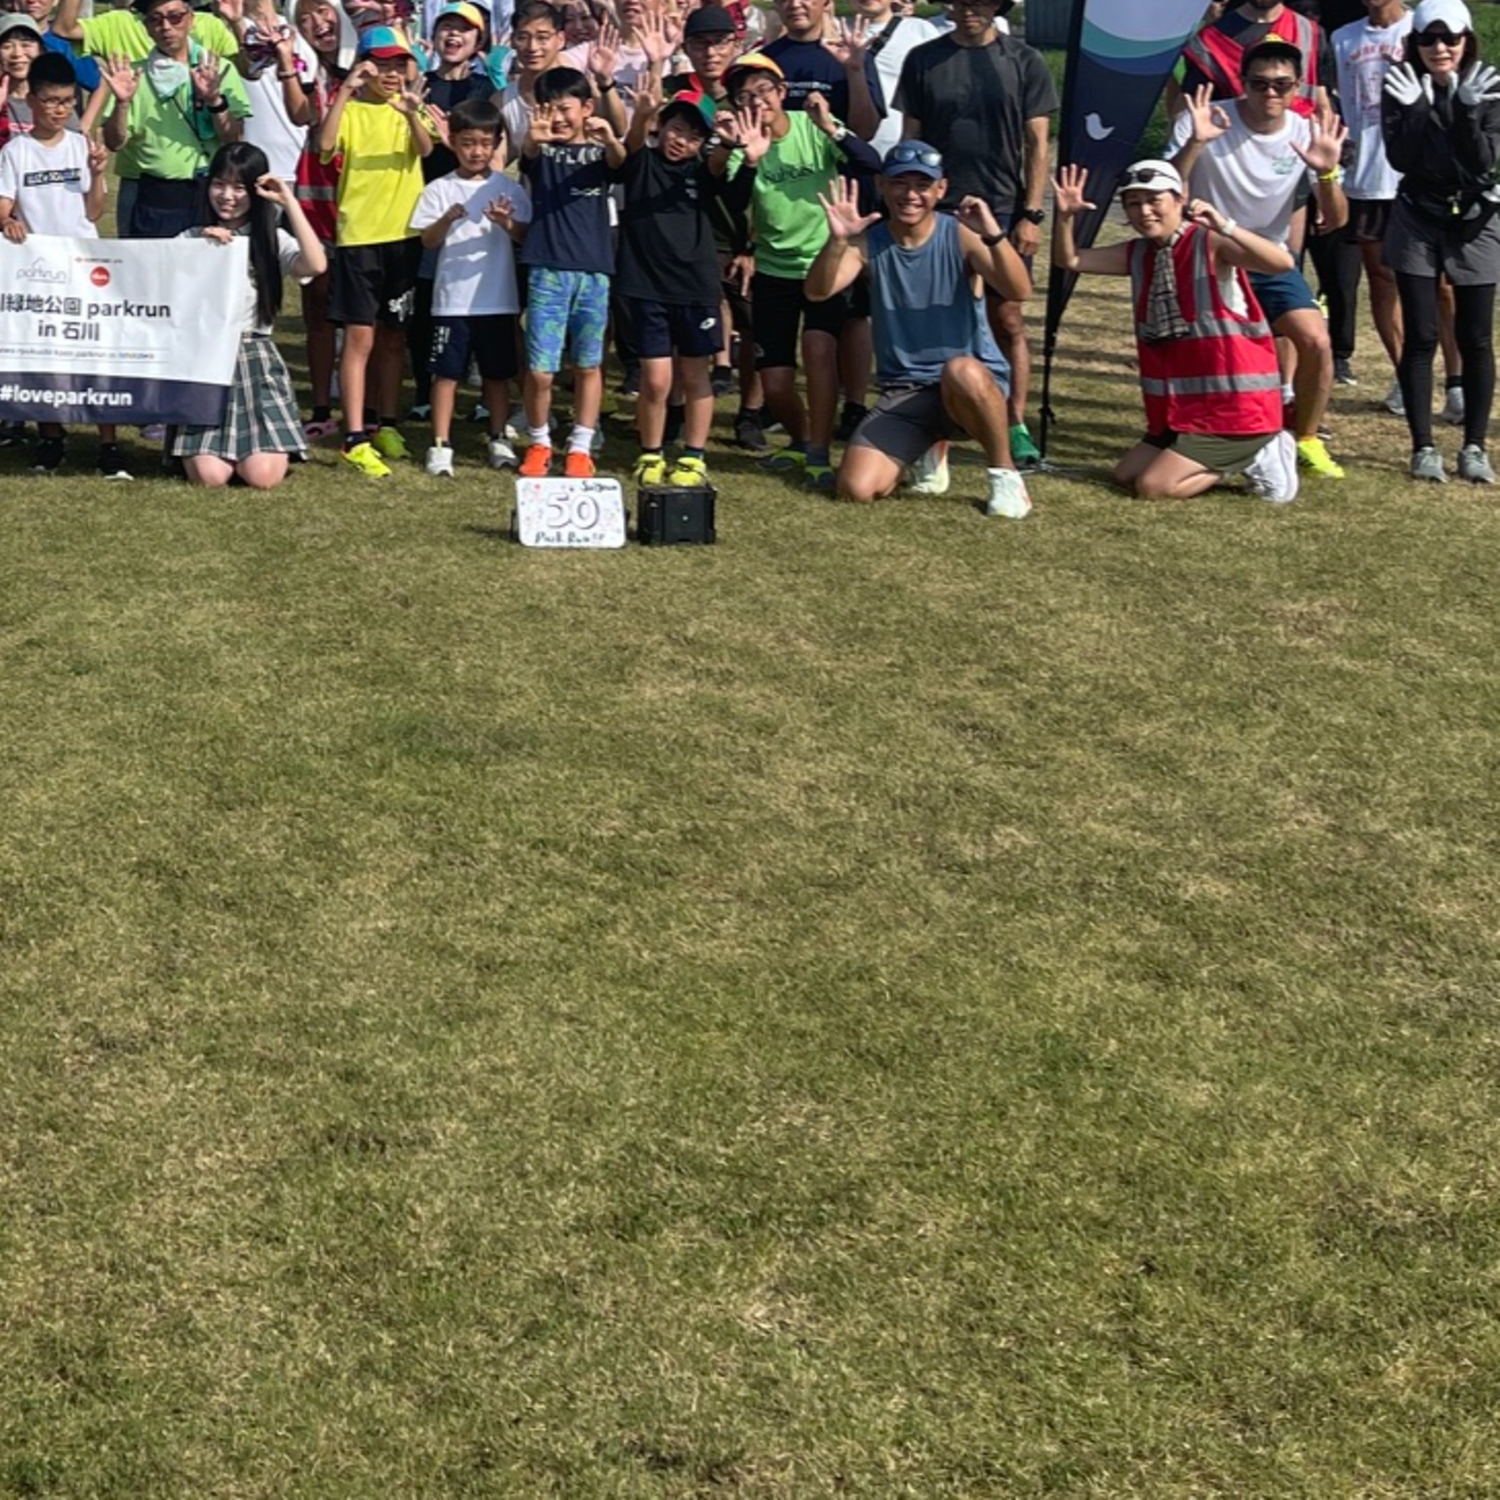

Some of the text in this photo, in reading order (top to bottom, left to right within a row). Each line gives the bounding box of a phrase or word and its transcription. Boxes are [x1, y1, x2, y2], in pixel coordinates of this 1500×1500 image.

[86, 299, 171, 319] parkrun
[37, 320, 101, 341] in 石川
[547, 492, 600, 530] 50
